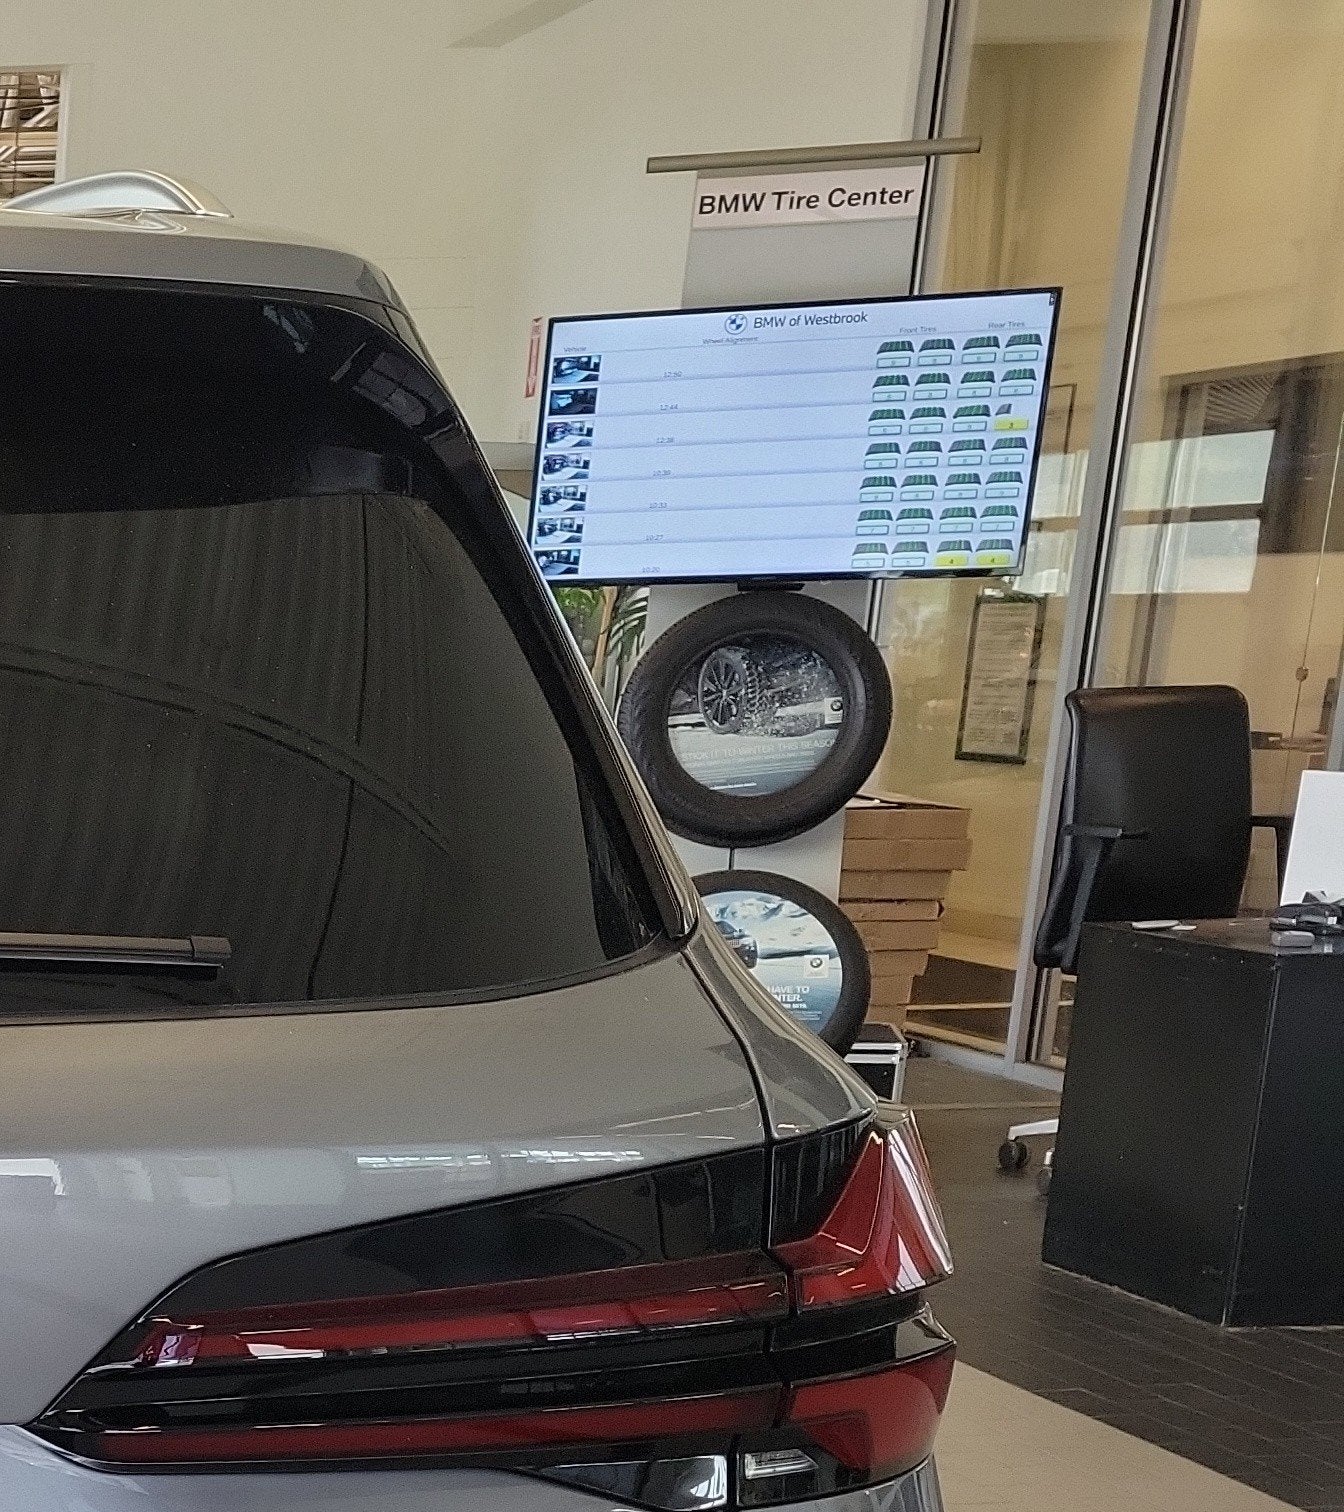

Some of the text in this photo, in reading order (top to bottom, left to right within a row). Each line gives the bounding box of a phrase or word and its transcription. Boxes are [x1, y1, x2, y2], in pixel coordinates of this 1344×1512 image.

[698, 187, 915, 214] BMW Tire Center
[753, 311, 868, 329] BMW of Westbrook
[796, 985, 810, 994] TO
